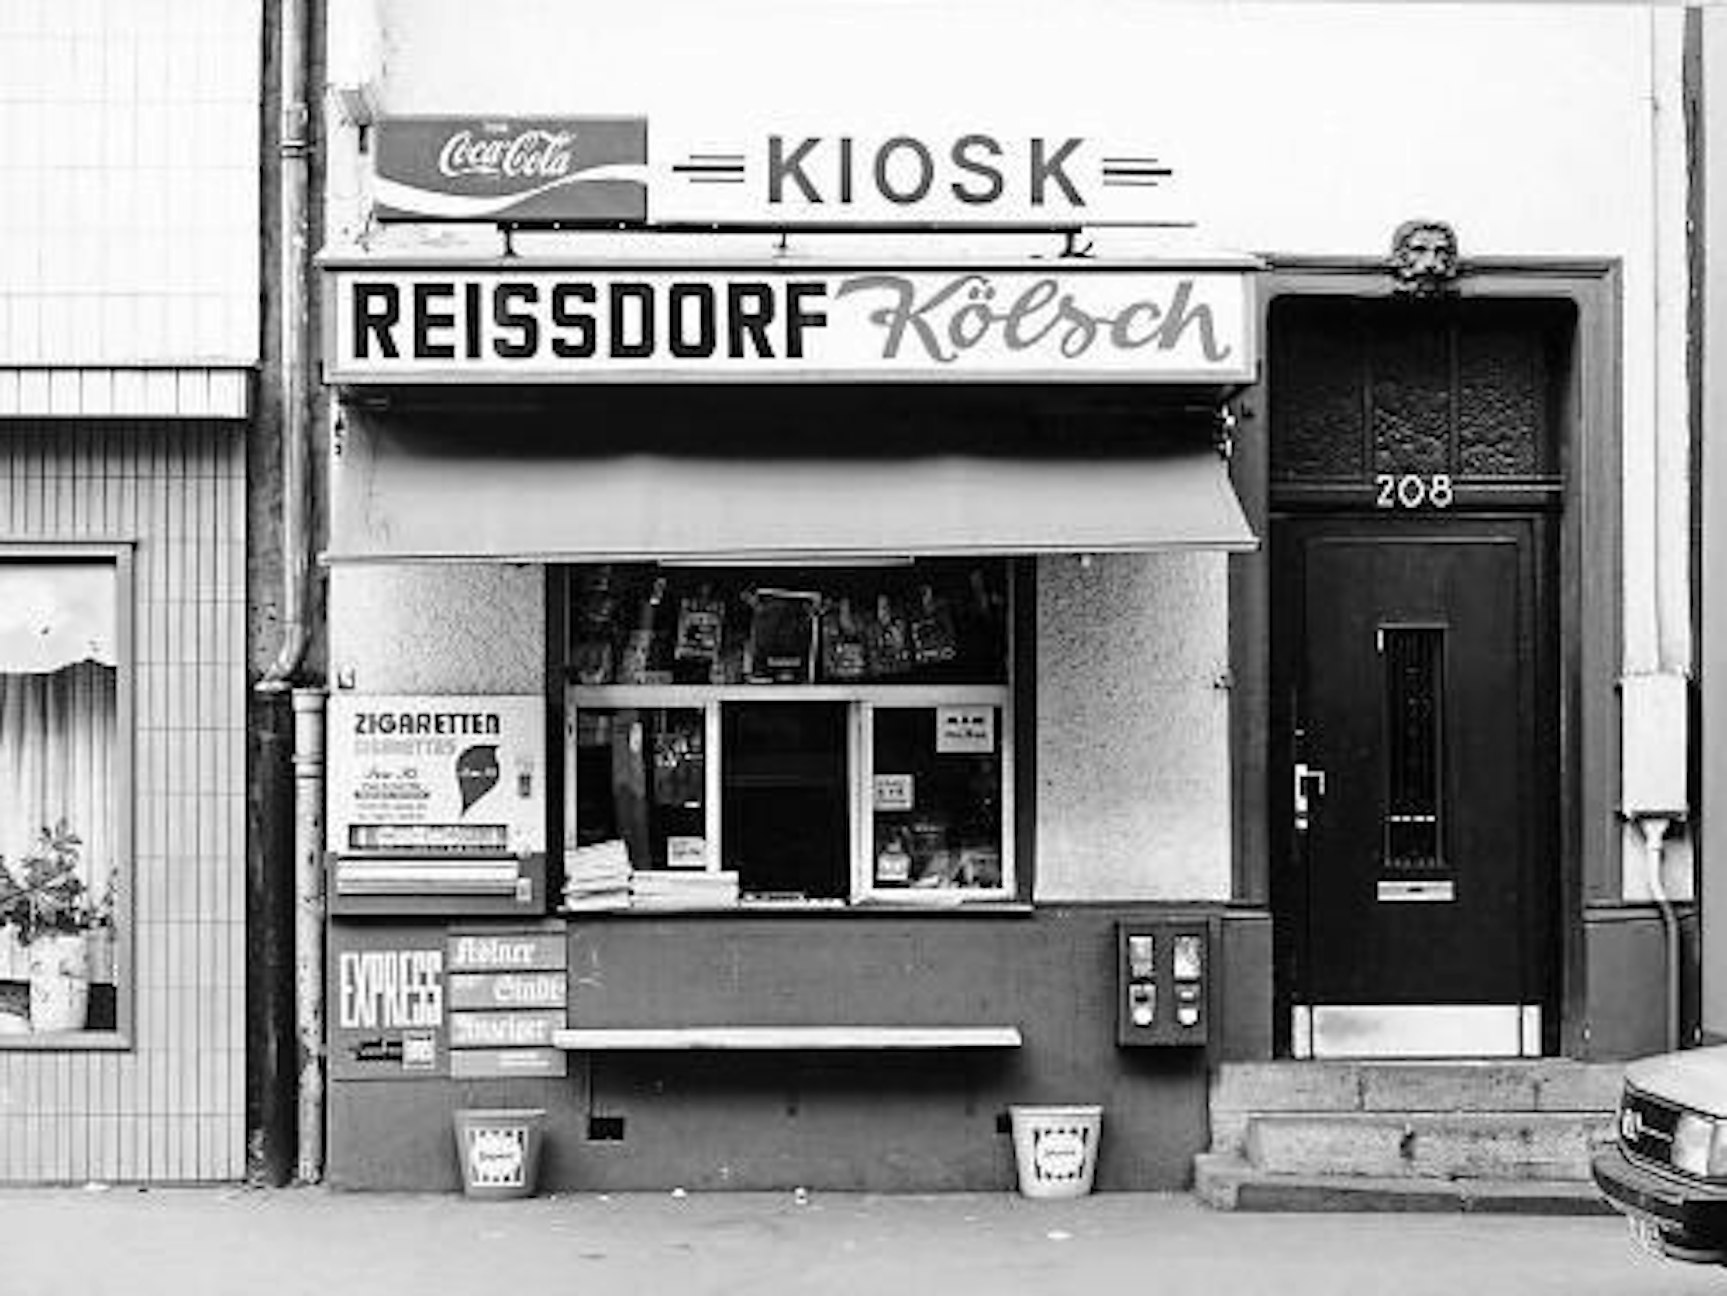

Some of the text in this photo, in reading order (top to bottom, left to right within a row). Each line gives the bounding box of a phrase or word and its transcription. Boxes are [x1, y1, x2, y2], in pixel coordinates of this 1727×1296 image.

[438, 129, 577, 177] Coca-Cola
[767, 134, 1087, 208] KIOSK
[352, 274, 1232, 363] REISSDORF Kölsch
[1375, 473, 1454, 509] 208
[355, 713, 500, 735] ZIGARETTEN
[340, 950, 443, 1029] EXPRESS
